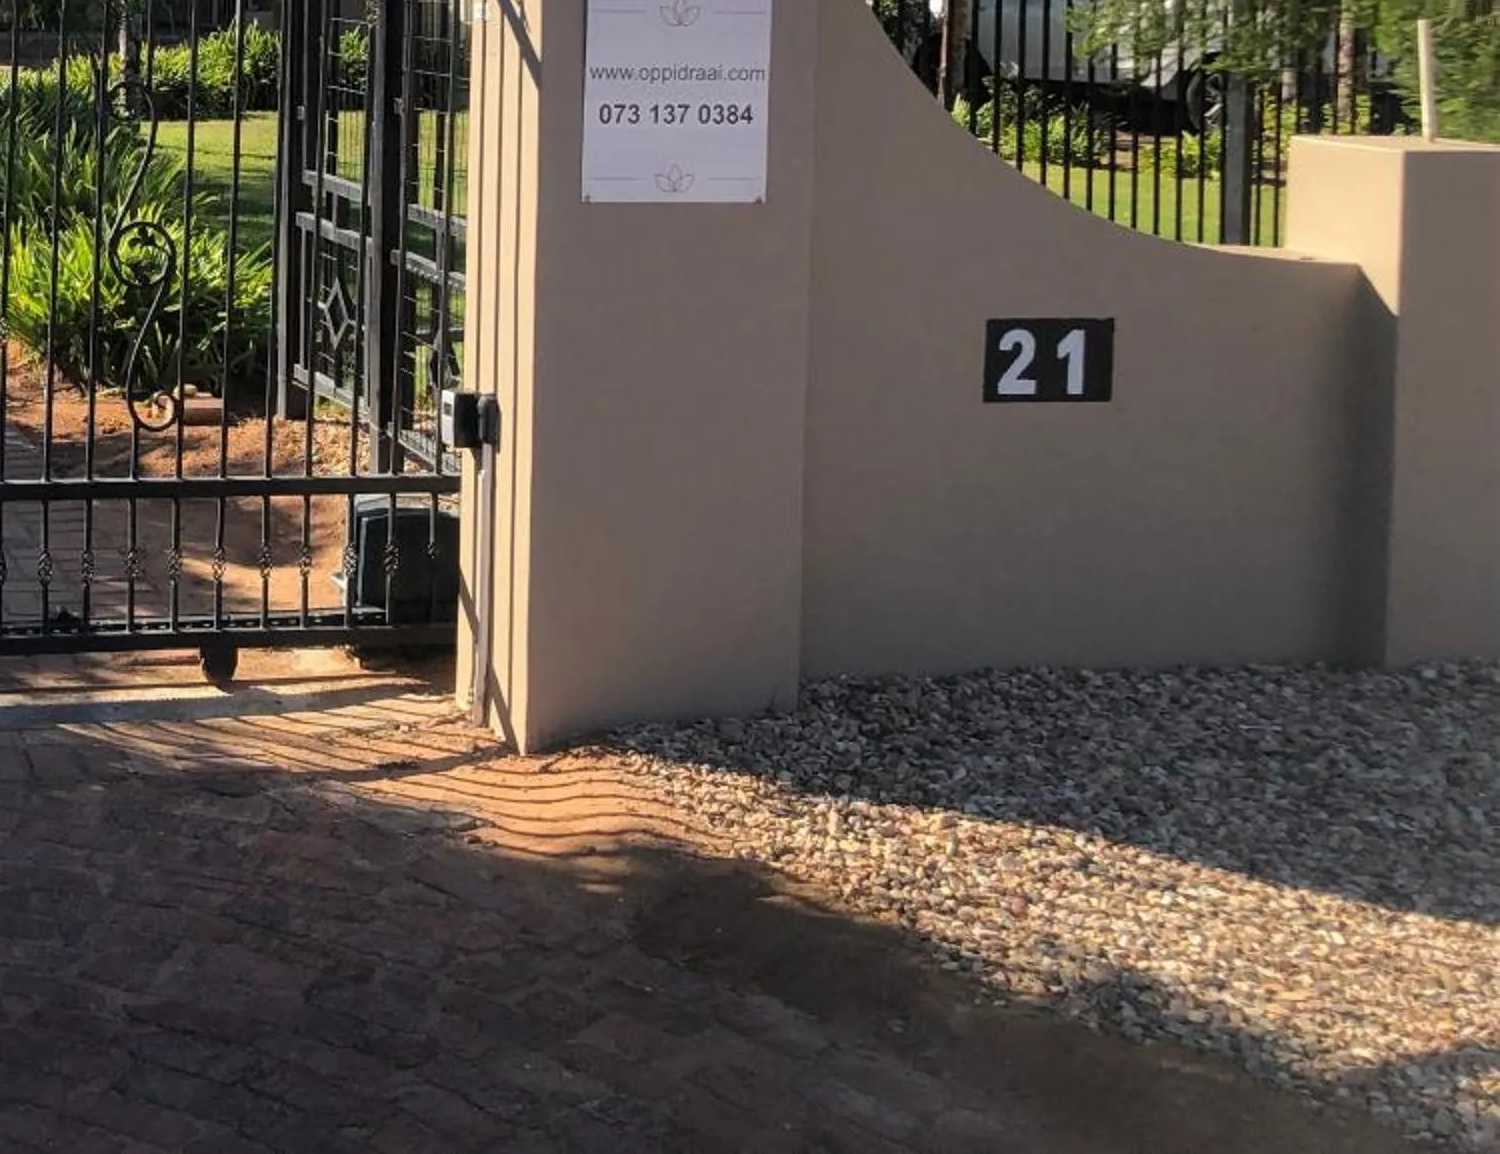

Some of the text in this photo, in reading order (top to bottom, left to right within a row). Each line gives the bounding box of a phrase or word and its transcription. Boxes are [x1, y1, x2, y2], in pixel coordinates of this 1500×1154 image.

[589, 63, 766, 85] www.oppidraai.com
[599, 103, 754, 125] 073 137 0384
[997, 328, 1086, 395] 21
